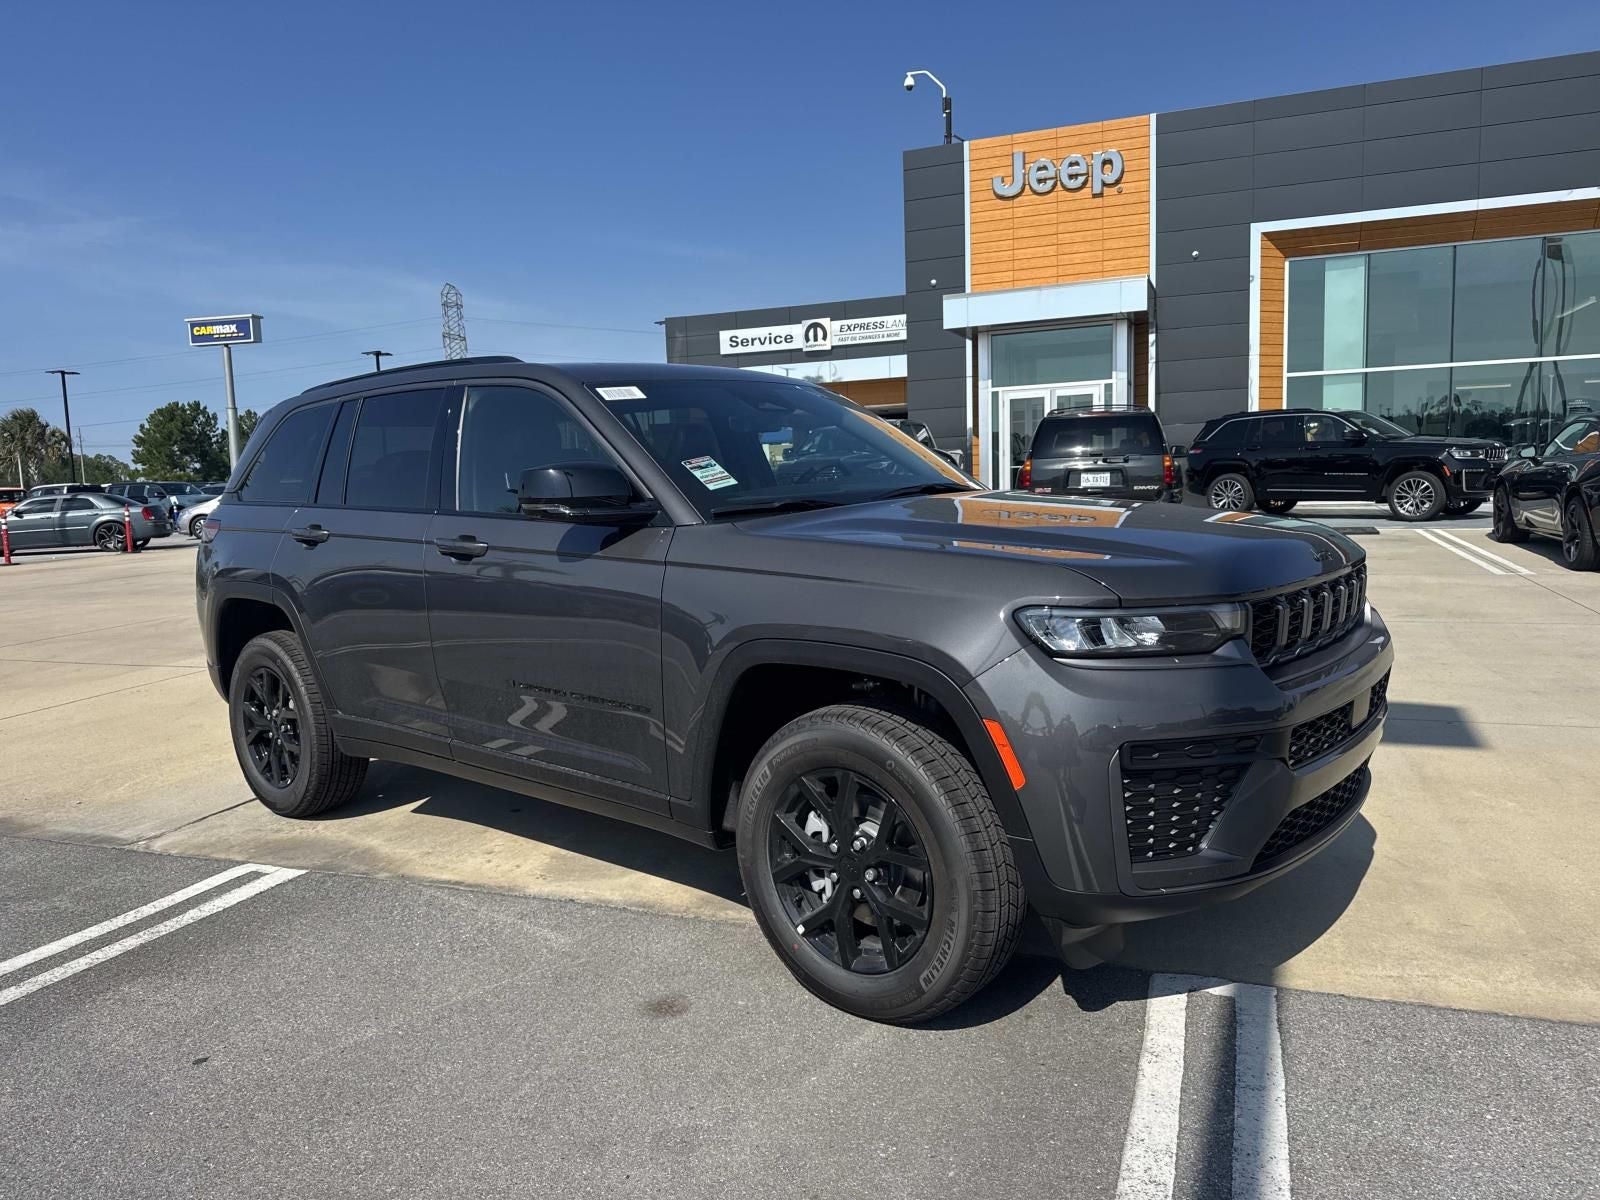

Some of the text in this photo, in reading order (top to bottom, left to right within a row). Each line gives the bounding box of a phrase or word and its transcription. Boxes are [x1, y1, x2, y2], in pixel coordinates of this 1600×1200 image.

[991, 148, 1124, 200] Jeep
[839, 319, 906, 332] EXPRESSLAN
[729, 332, 794, 348] Service
[858, 333, 881, 341] CHANGES
[886, 331, 901, 339] MORE
[922, 918, 957, 988] MICHELIN
